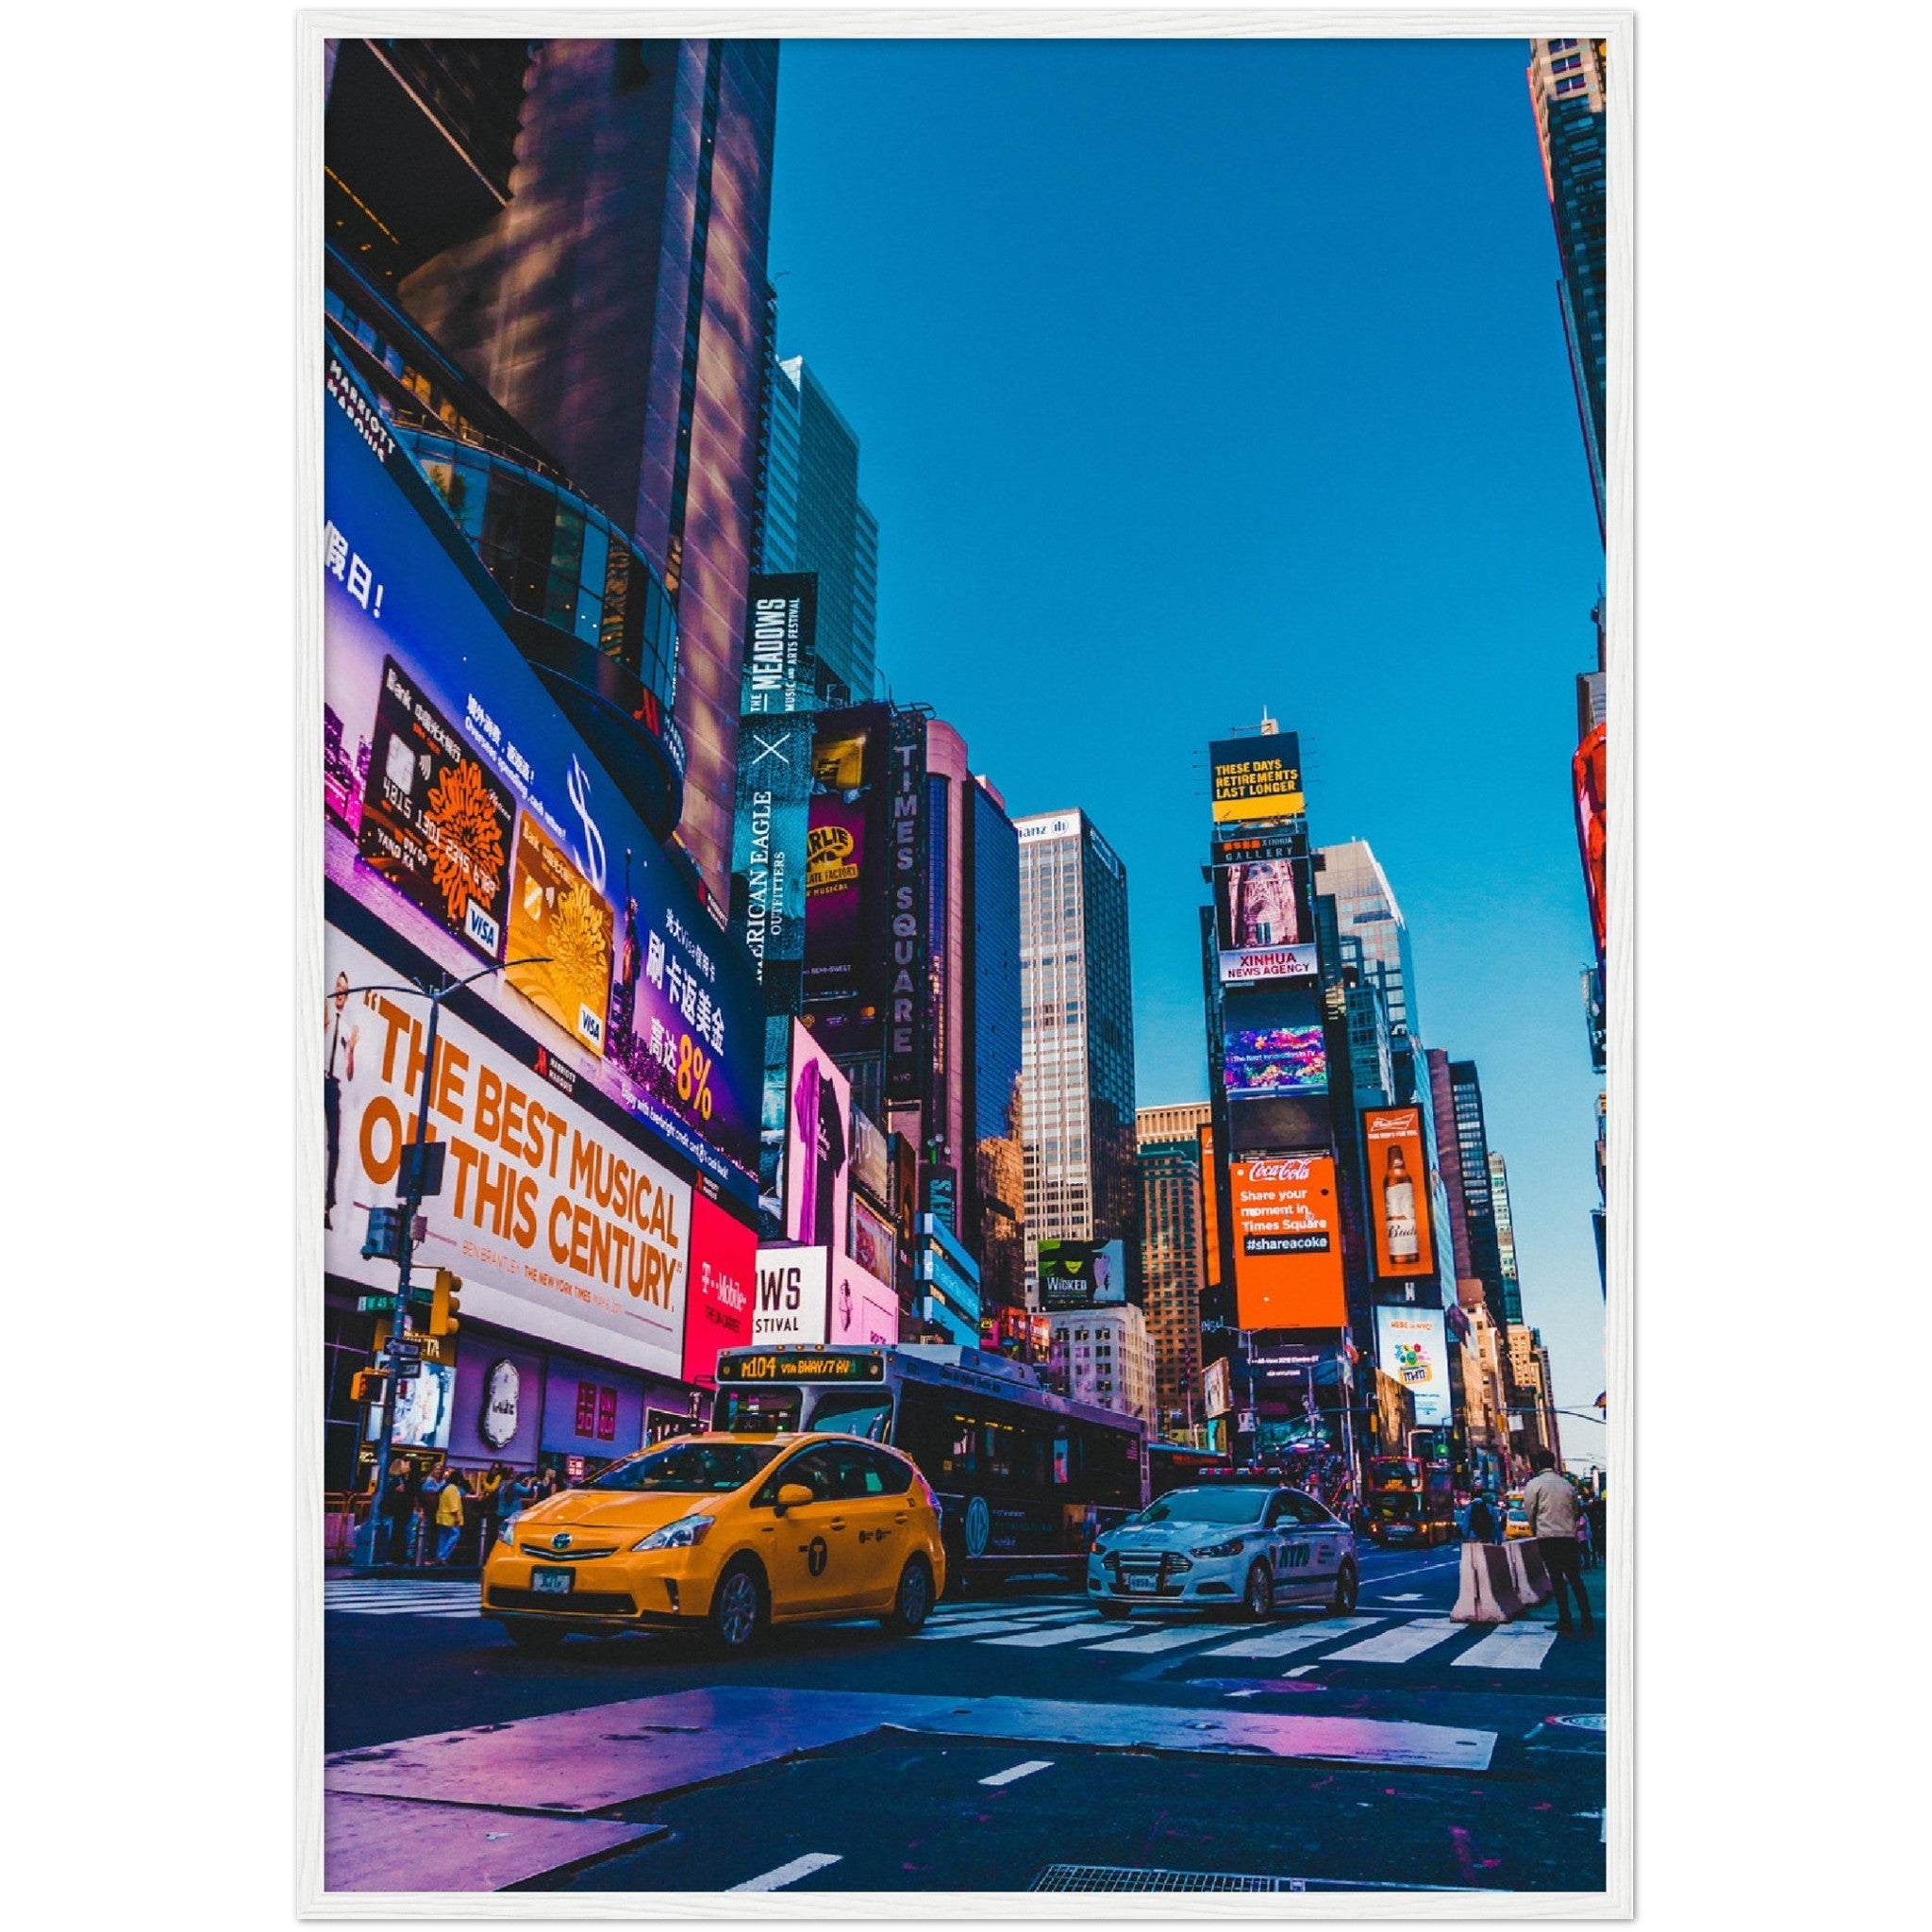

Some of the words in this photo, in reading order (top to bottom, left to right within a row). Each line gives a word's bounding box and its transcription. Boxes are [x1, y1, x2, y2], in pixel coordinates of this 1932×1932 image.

[330, 359, 395, 454] MARRIOTT
[788, 597, 801, 640] FESTIVAL
[752, 598, 786, 691] MEADOWS
[787, 641, 798, 665] ARTS
[750, 693, 762, 712] THE
[785, 681, 797, 712] MUSIC
[1215, 761, 1251, 775] THESE
[1253, 758, 1283, 772] DAYS
[1215, 769, 1299, 789] RETIREMENTS
[1216, 786, 1245, 799] LAST
[1249, 780, 1296, 796] LONGER
[893, 744, 917, 871] TIMES
[751, 791, 772, 864] EAGLE
[1225, 847, 1292, 861] GALLERY
[1261, 837, 1293, 847] XINHUA
[824, 867, 856, 880] FACTORY
[770, 851, 786, 937] OUTFITTERS
[814, 884, 848, 896] MUSICAL
[471, 908, 494, 948] VISA
[892, 886, 916, 1054] SQUARE
[1228, 967, 1260, 978] NEWS
[1263, 963, 1310, 975] AGENCY
[1240, 952, 1297, 967] XINHUA
[646, 929, 724, 1057] 刷卡返美金
[582, 1010, 600, 1041] VISA
[474, 1064, 568, 1178] BEST
[569, 1129, 679, 1249] MUSICAL
[1248, 1158, 1312, 1182] Coca-Cola
[449, 1135, 539, 1249] THIS
[1241, 1191, 1275, 1202] Share
[1279, 1190, 1307, 1202] your
[1241, 1204, 1293, 1217] moment
[1296, 1203, 1308, 1214] in
[1241, 1221, 1279, 1232] Times
[1282, 1219, 1327, 1232] Square
[1245, 1236, 1328, 1251] #shareacoke
[462, 1240, 478, 1258] BEN
[480, 1247, 520, 1274] BRANTLEY
[525, 1264, 538, 1282] THE
[539, 1272, 555, 1289] NEW
[556, 1279, 573, 1296] YORK
[574, 1285, 591, 1304] TIMES
[756, 1267, 801, 1312] WS
[741, 1357, 777, 1379] M104
[836, 1359, 850, 1374] AV
